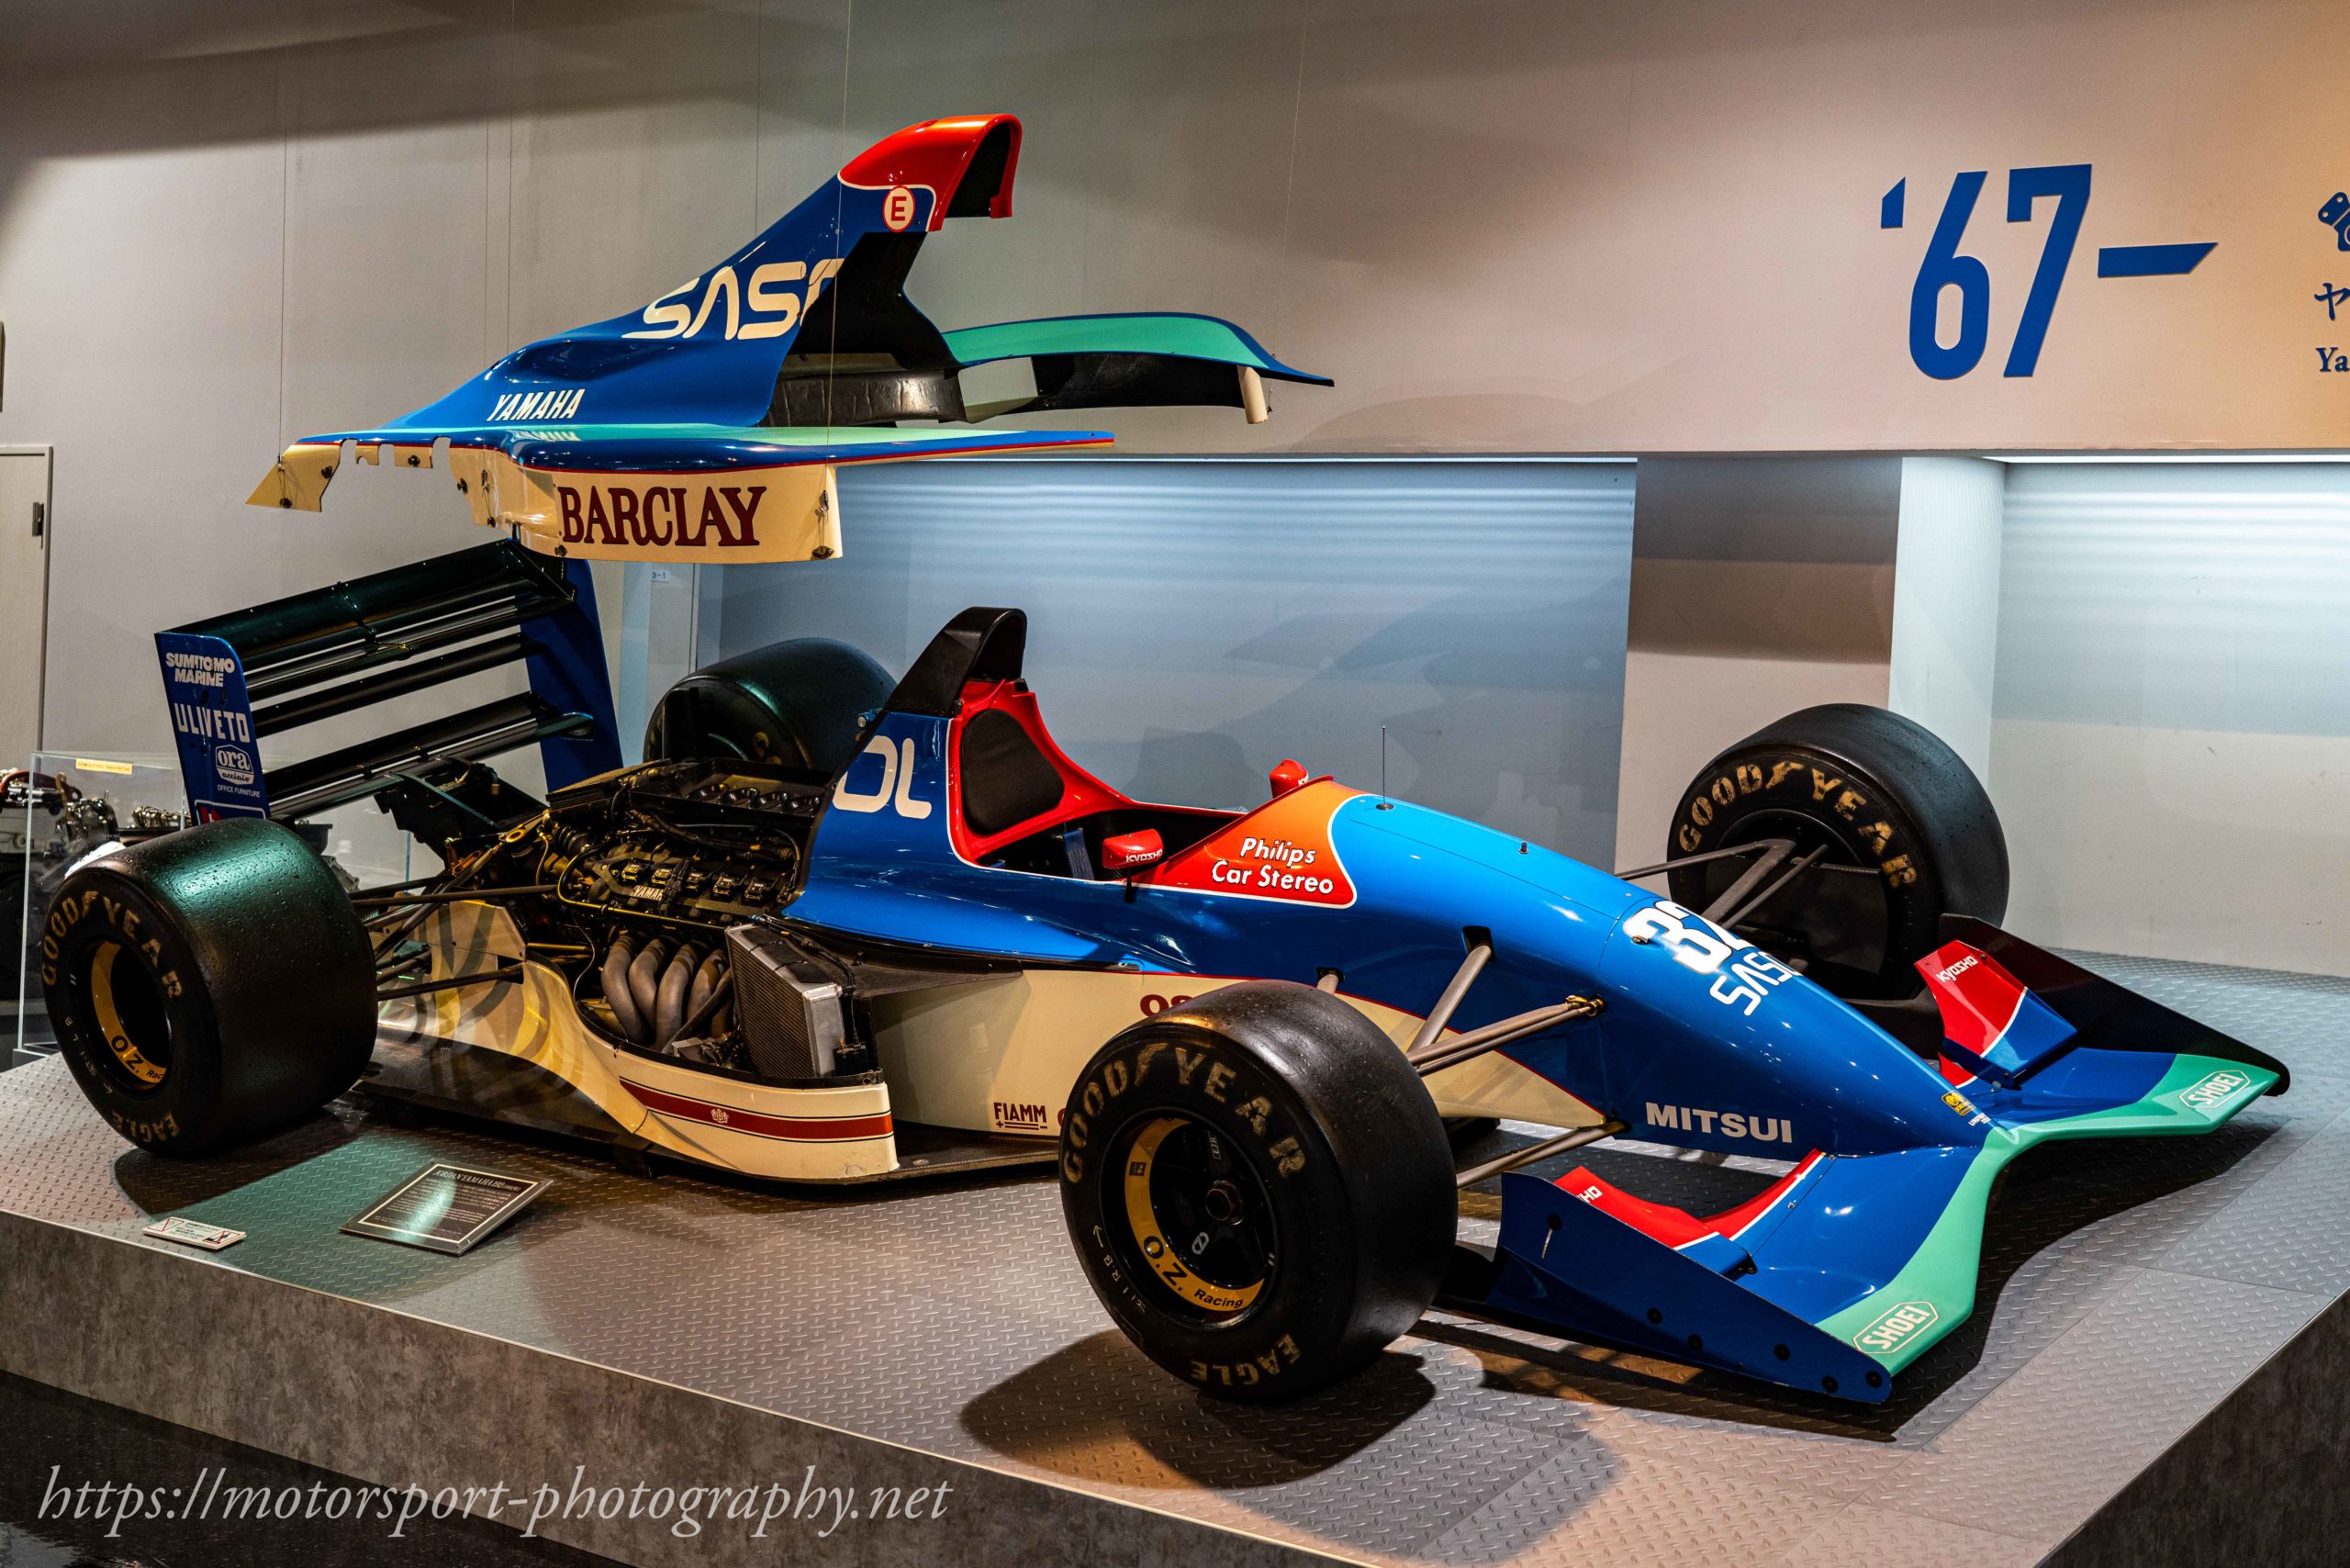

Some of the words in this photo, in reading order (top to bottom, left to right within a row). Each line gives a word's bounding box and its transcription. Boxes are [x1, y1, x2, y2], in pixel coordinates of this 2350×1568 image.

[890, 196, 908, 222] E
[486, 388, 586, 421] YAMAHA
[557, 486, 767, 547] BARCLAY
[165, 652, 235, 674] SUMITOMO
[174, 668, 224, 688] MARINE
[173, 702, 251, 744] ULIVETO
[217, 749, 251, 770] ora
[217, 784, 234, 794] OFFICE
[234, 787, 261, 798] FURNITURE
[1679, 761, 1918, 889] GOODYEAR
[1125, 848, 1163, 863] KYOSHO
[1239, 836, 1316, 868] Philips
[1212, 860, 1253, 885] Car
[1258, 864, 1334, 895] Stereo
[41, 890, 182, 999] GOODYEAR
[2188, 1073, 2244, 1105] SHOEI
[993, 1102, 1047, 1124] FIAMM
[1064, 1042, 1305, 1183] GOODYEAR
[1645, 1102, 1793, 1144] MITSUI
[1194, 1289, 1244, 1309] Racing
[1862, 1305, 1931, 1350] SHOEI
[1191, 1334, 1301, 1385] EAGLE
